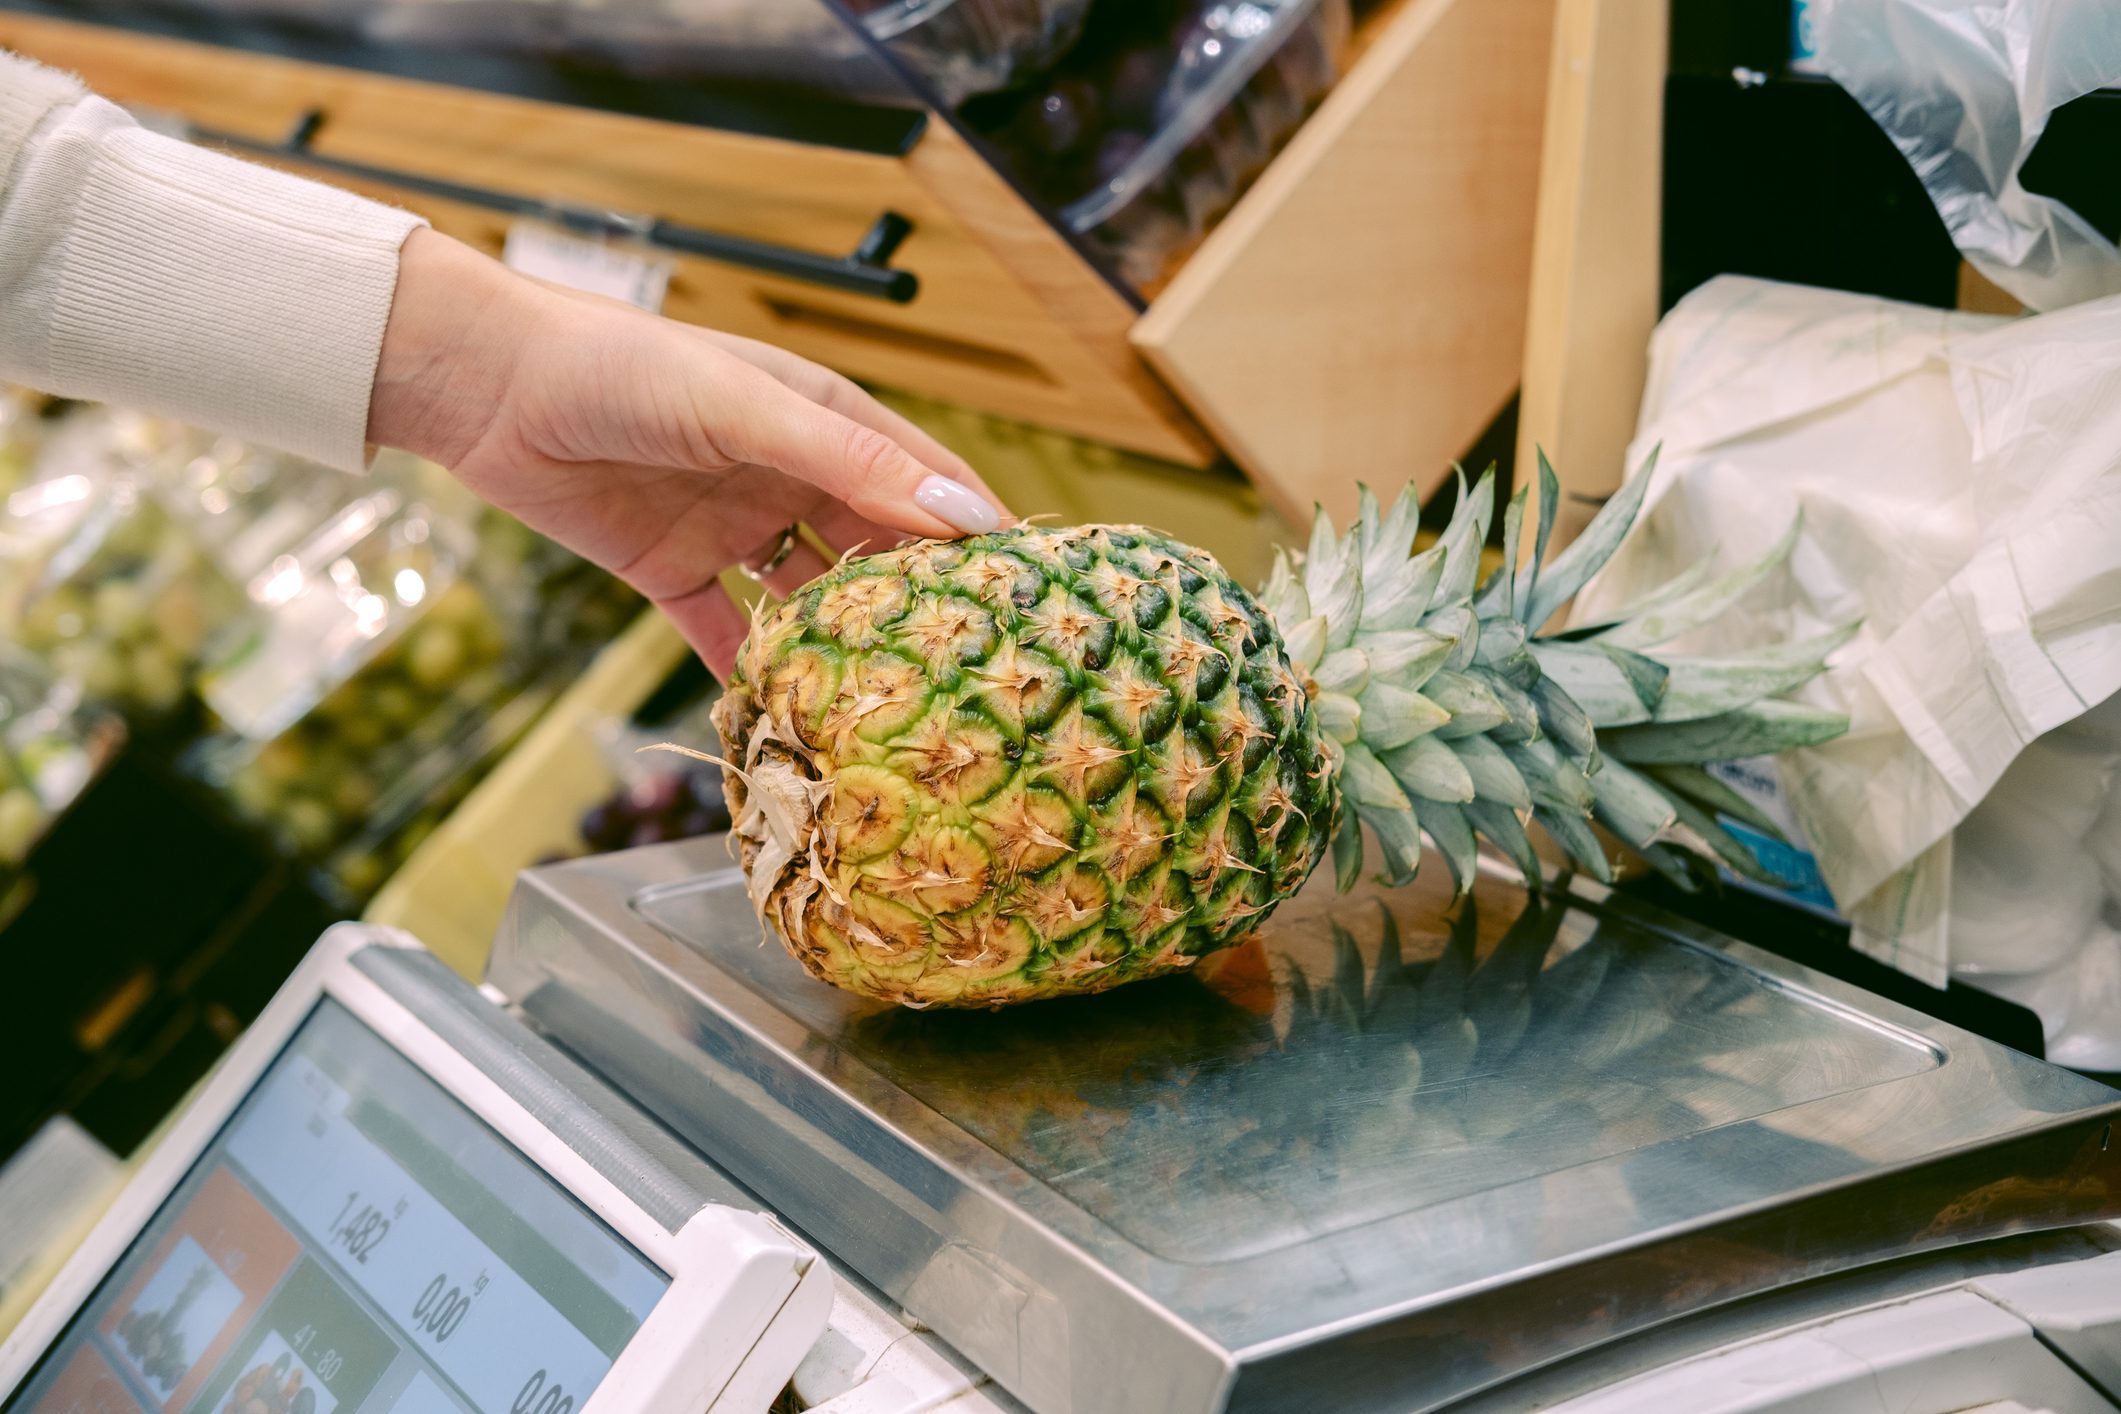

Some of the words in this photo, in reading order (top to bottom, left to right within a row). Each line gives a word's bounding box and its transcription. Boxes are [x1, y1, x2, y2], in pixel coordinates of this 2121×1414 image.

[327, 1191, 391, 1265] 1,482
[411, 1273, 472, 1344] 0,00
[294, 1324, 317, 1355] 41
[316, 1348, 343, 1382] 80
